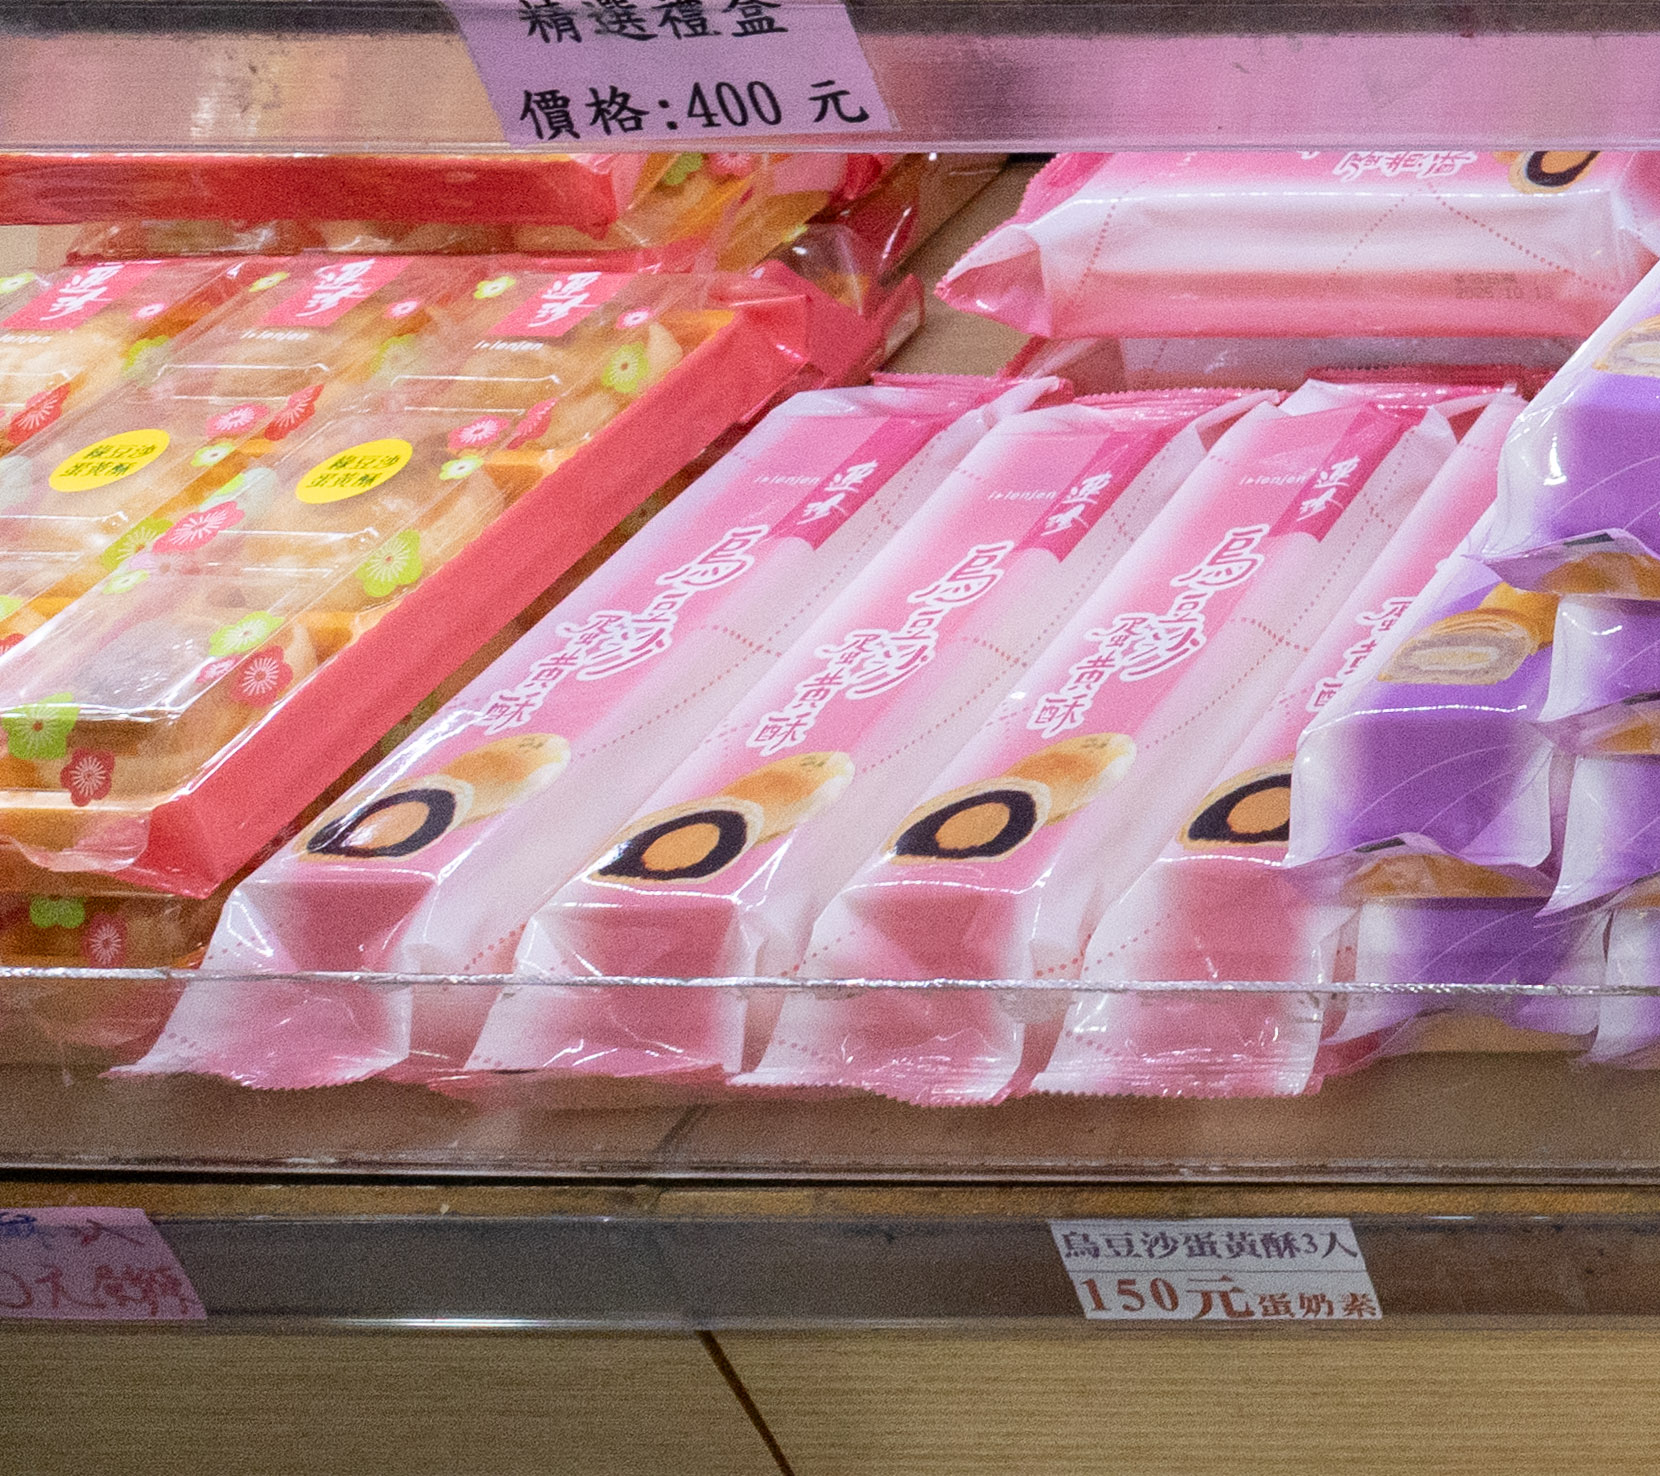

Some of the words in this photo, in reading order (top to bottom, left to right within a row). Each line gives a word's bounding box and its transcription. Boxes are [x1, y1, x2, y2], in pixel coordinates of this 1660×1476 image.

[1082, 1275, 1255, 1320] 150元
[1257, 1292, 1383, 1319] 蛋奶素
